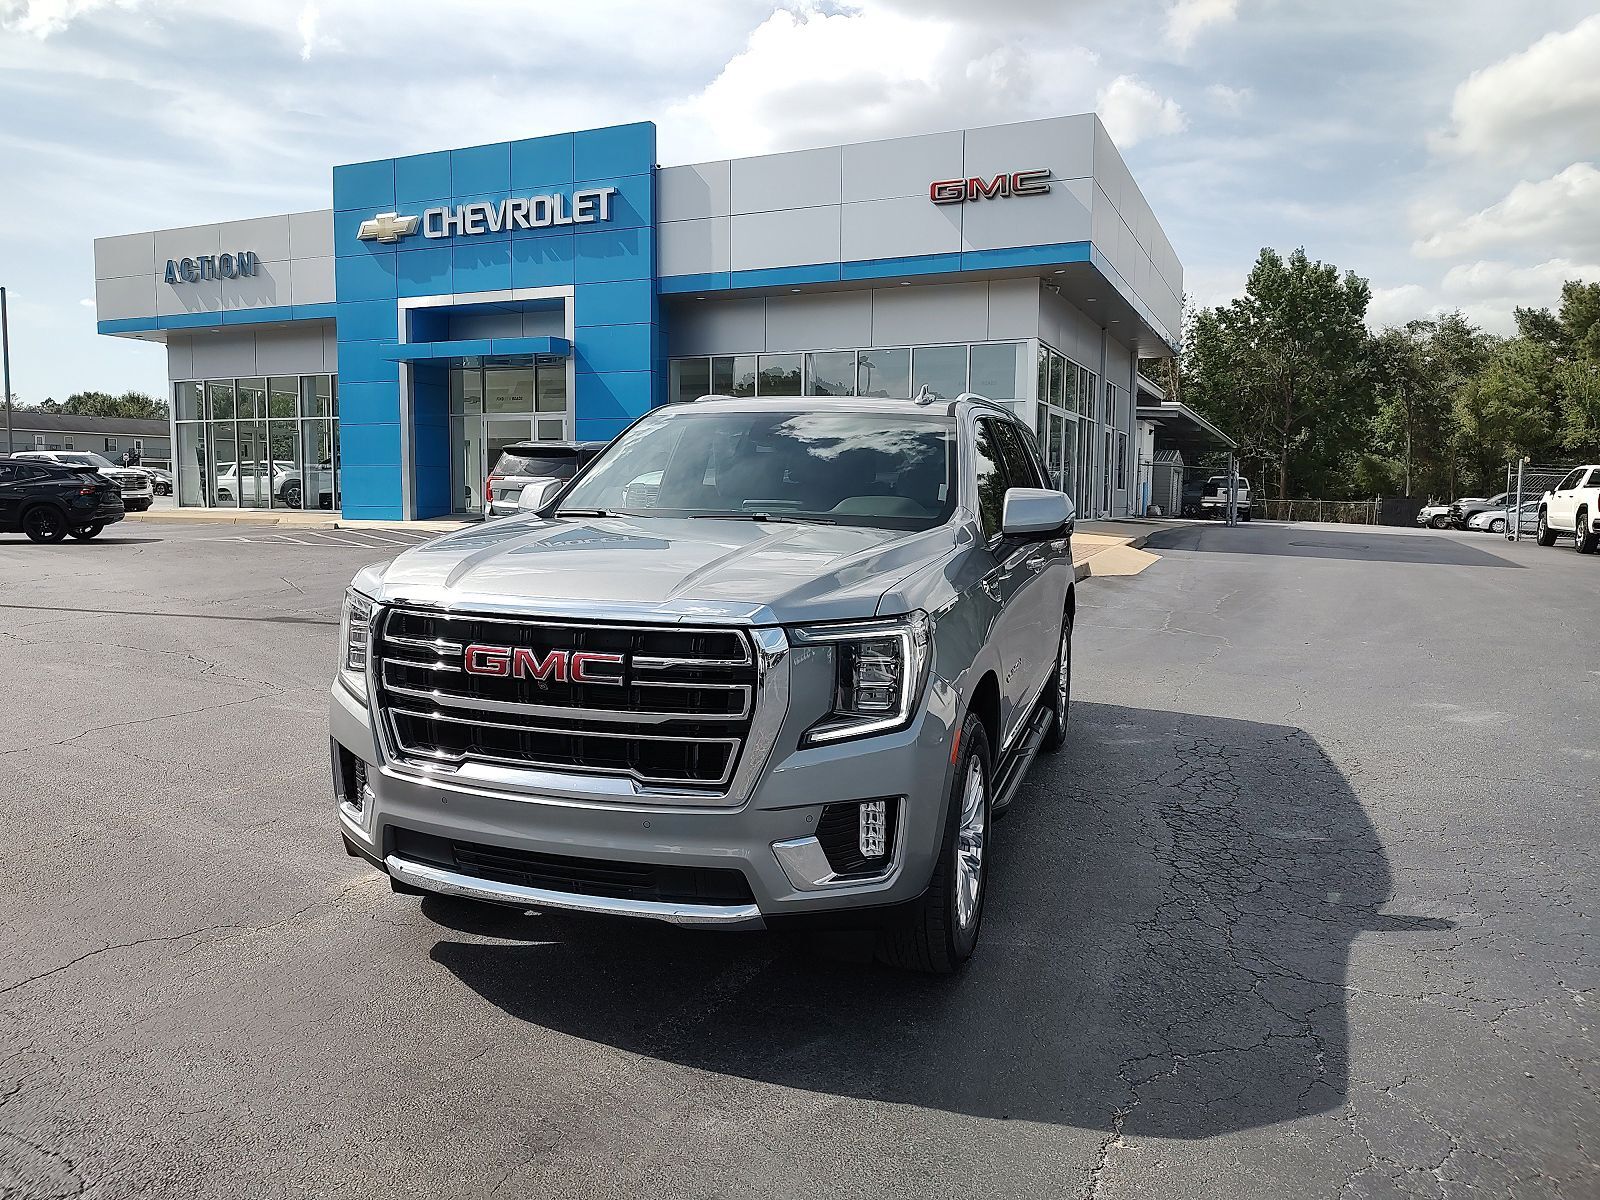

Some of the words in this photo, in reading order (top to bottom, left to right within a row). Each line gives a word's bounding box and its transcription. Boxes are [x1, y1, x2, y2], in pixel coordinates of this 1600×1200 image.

[929, 168, 1050, 204] GMC
[423, 187, 617, 240] CHEVROLET
[164, 251, 257, 284] ACTION
[465, 644, 625, 687] GMC
